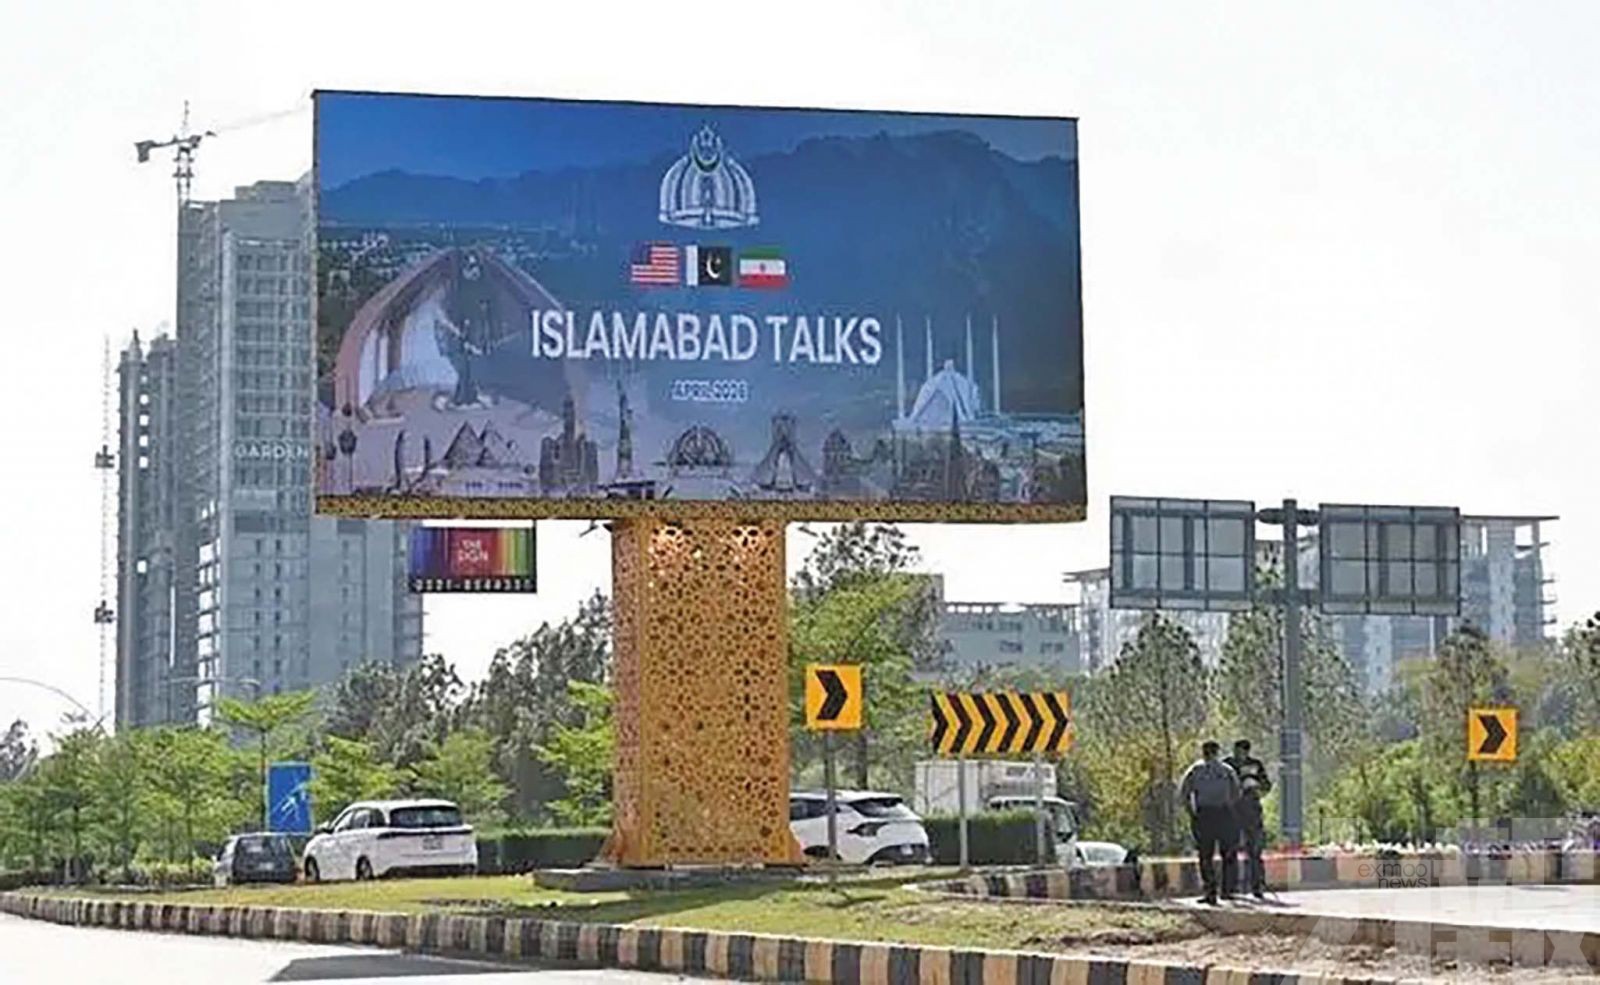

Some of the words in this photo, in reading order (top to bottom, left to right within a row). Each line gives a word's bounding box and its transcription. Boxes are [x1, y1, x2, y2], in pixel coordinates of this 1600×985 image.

[532, 309, 758, 362] ISLAMABAD
[766, 315, 882, 364] TALKS
[671, 379, 711, 401] APRIL
